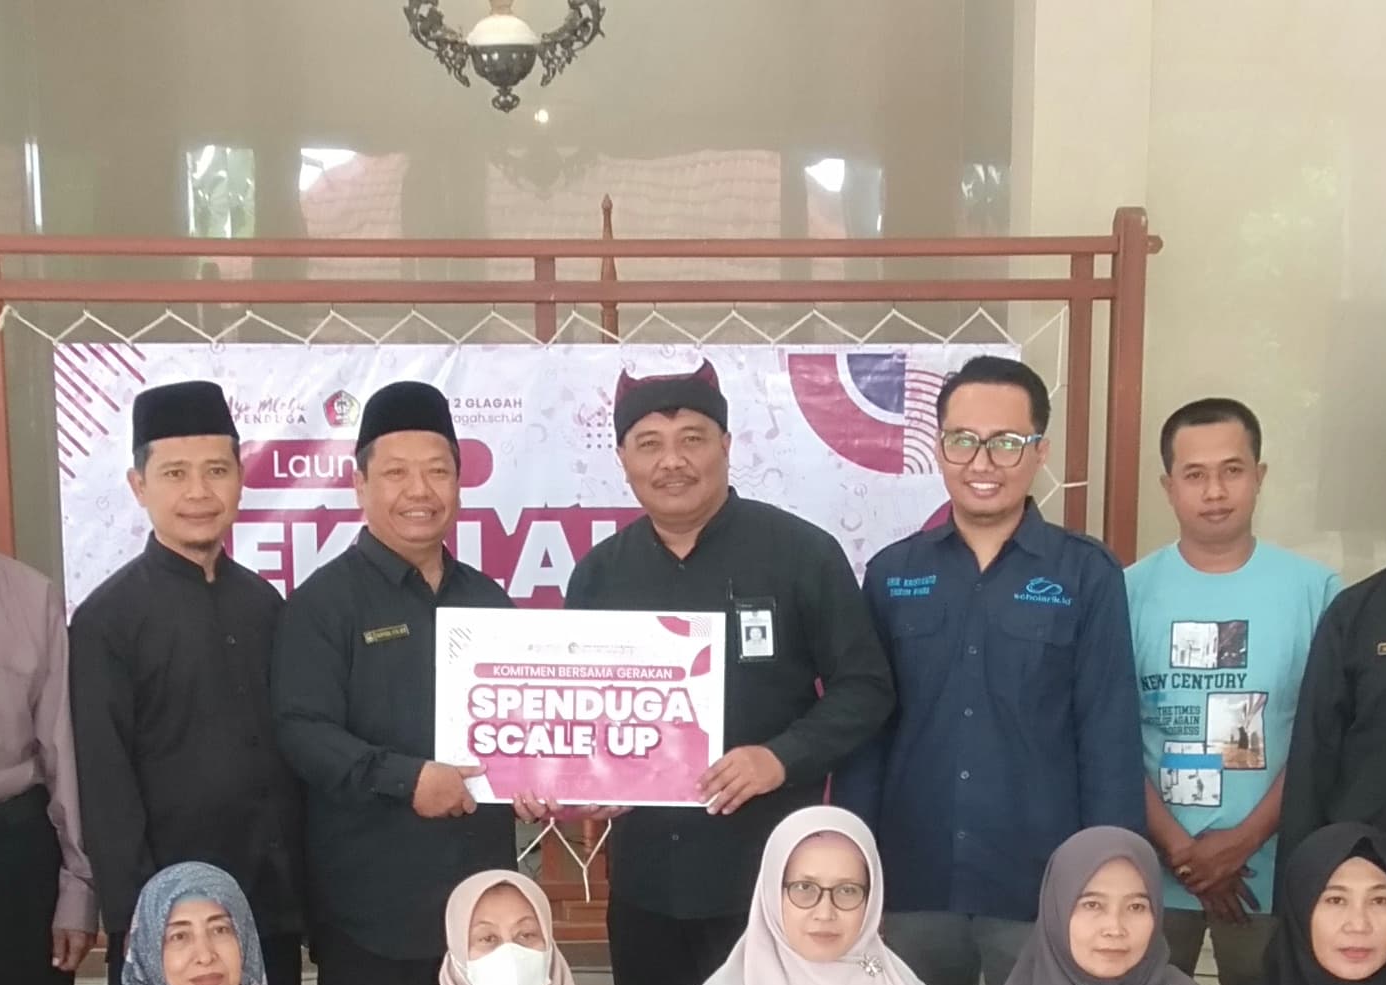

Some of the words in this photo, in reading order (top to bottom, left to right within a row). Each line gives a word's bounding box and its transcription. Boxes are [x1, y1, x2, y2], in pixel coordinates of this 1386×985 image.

[454, 399, 462, 409] 2
[465, 399, 523, 409] GLAGAH
[234, 414, 307, 424] PENDUGA
[453, 413, 523, 426] agah.sch.id
[273, 450, 358, 478] Laun
[492, 665, 556, 678] KOMITMEN
[558, 666, 614, 679] BERSAMA
[616, 667, 673, 680] GERAKAN
[1140, 673, 1168, 691] NEW
[1171, 673, 1247, 690] CENTURY
[469, 686, 695, 722] SPENDUGA
[1174, 705, 1201, 715] TIMES
[472, 724, 596, 756] SCALE
[606, 724, 659, 756] UP
